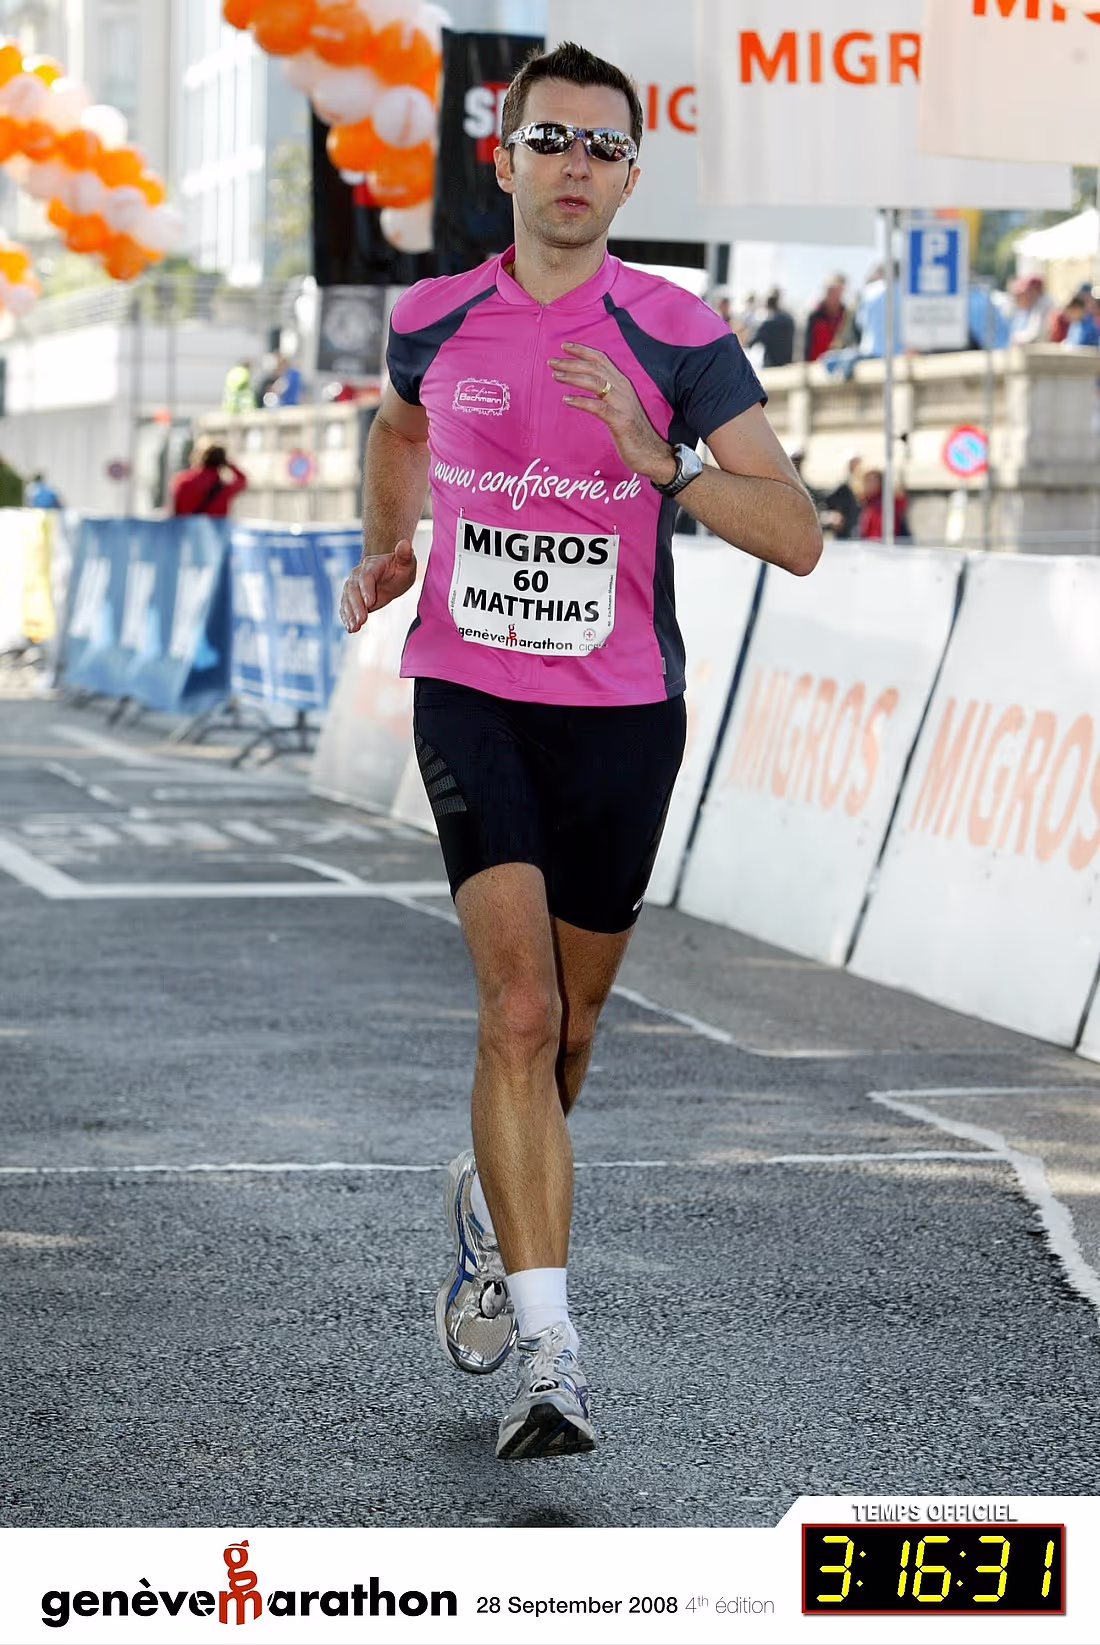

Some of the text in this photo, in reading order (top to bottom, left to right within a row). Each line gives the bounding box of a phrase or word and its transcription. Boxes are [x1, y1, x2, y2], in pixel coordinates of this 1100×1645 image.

[434, 458, 642, 510] www.confiserie.ch
[463, 523, 609, 565] MIGROS
[513, 569, 549, 593] 60
[463, 586, 600, 622] MATTHIAS
[728, 667, 899, 817] MIGROS
